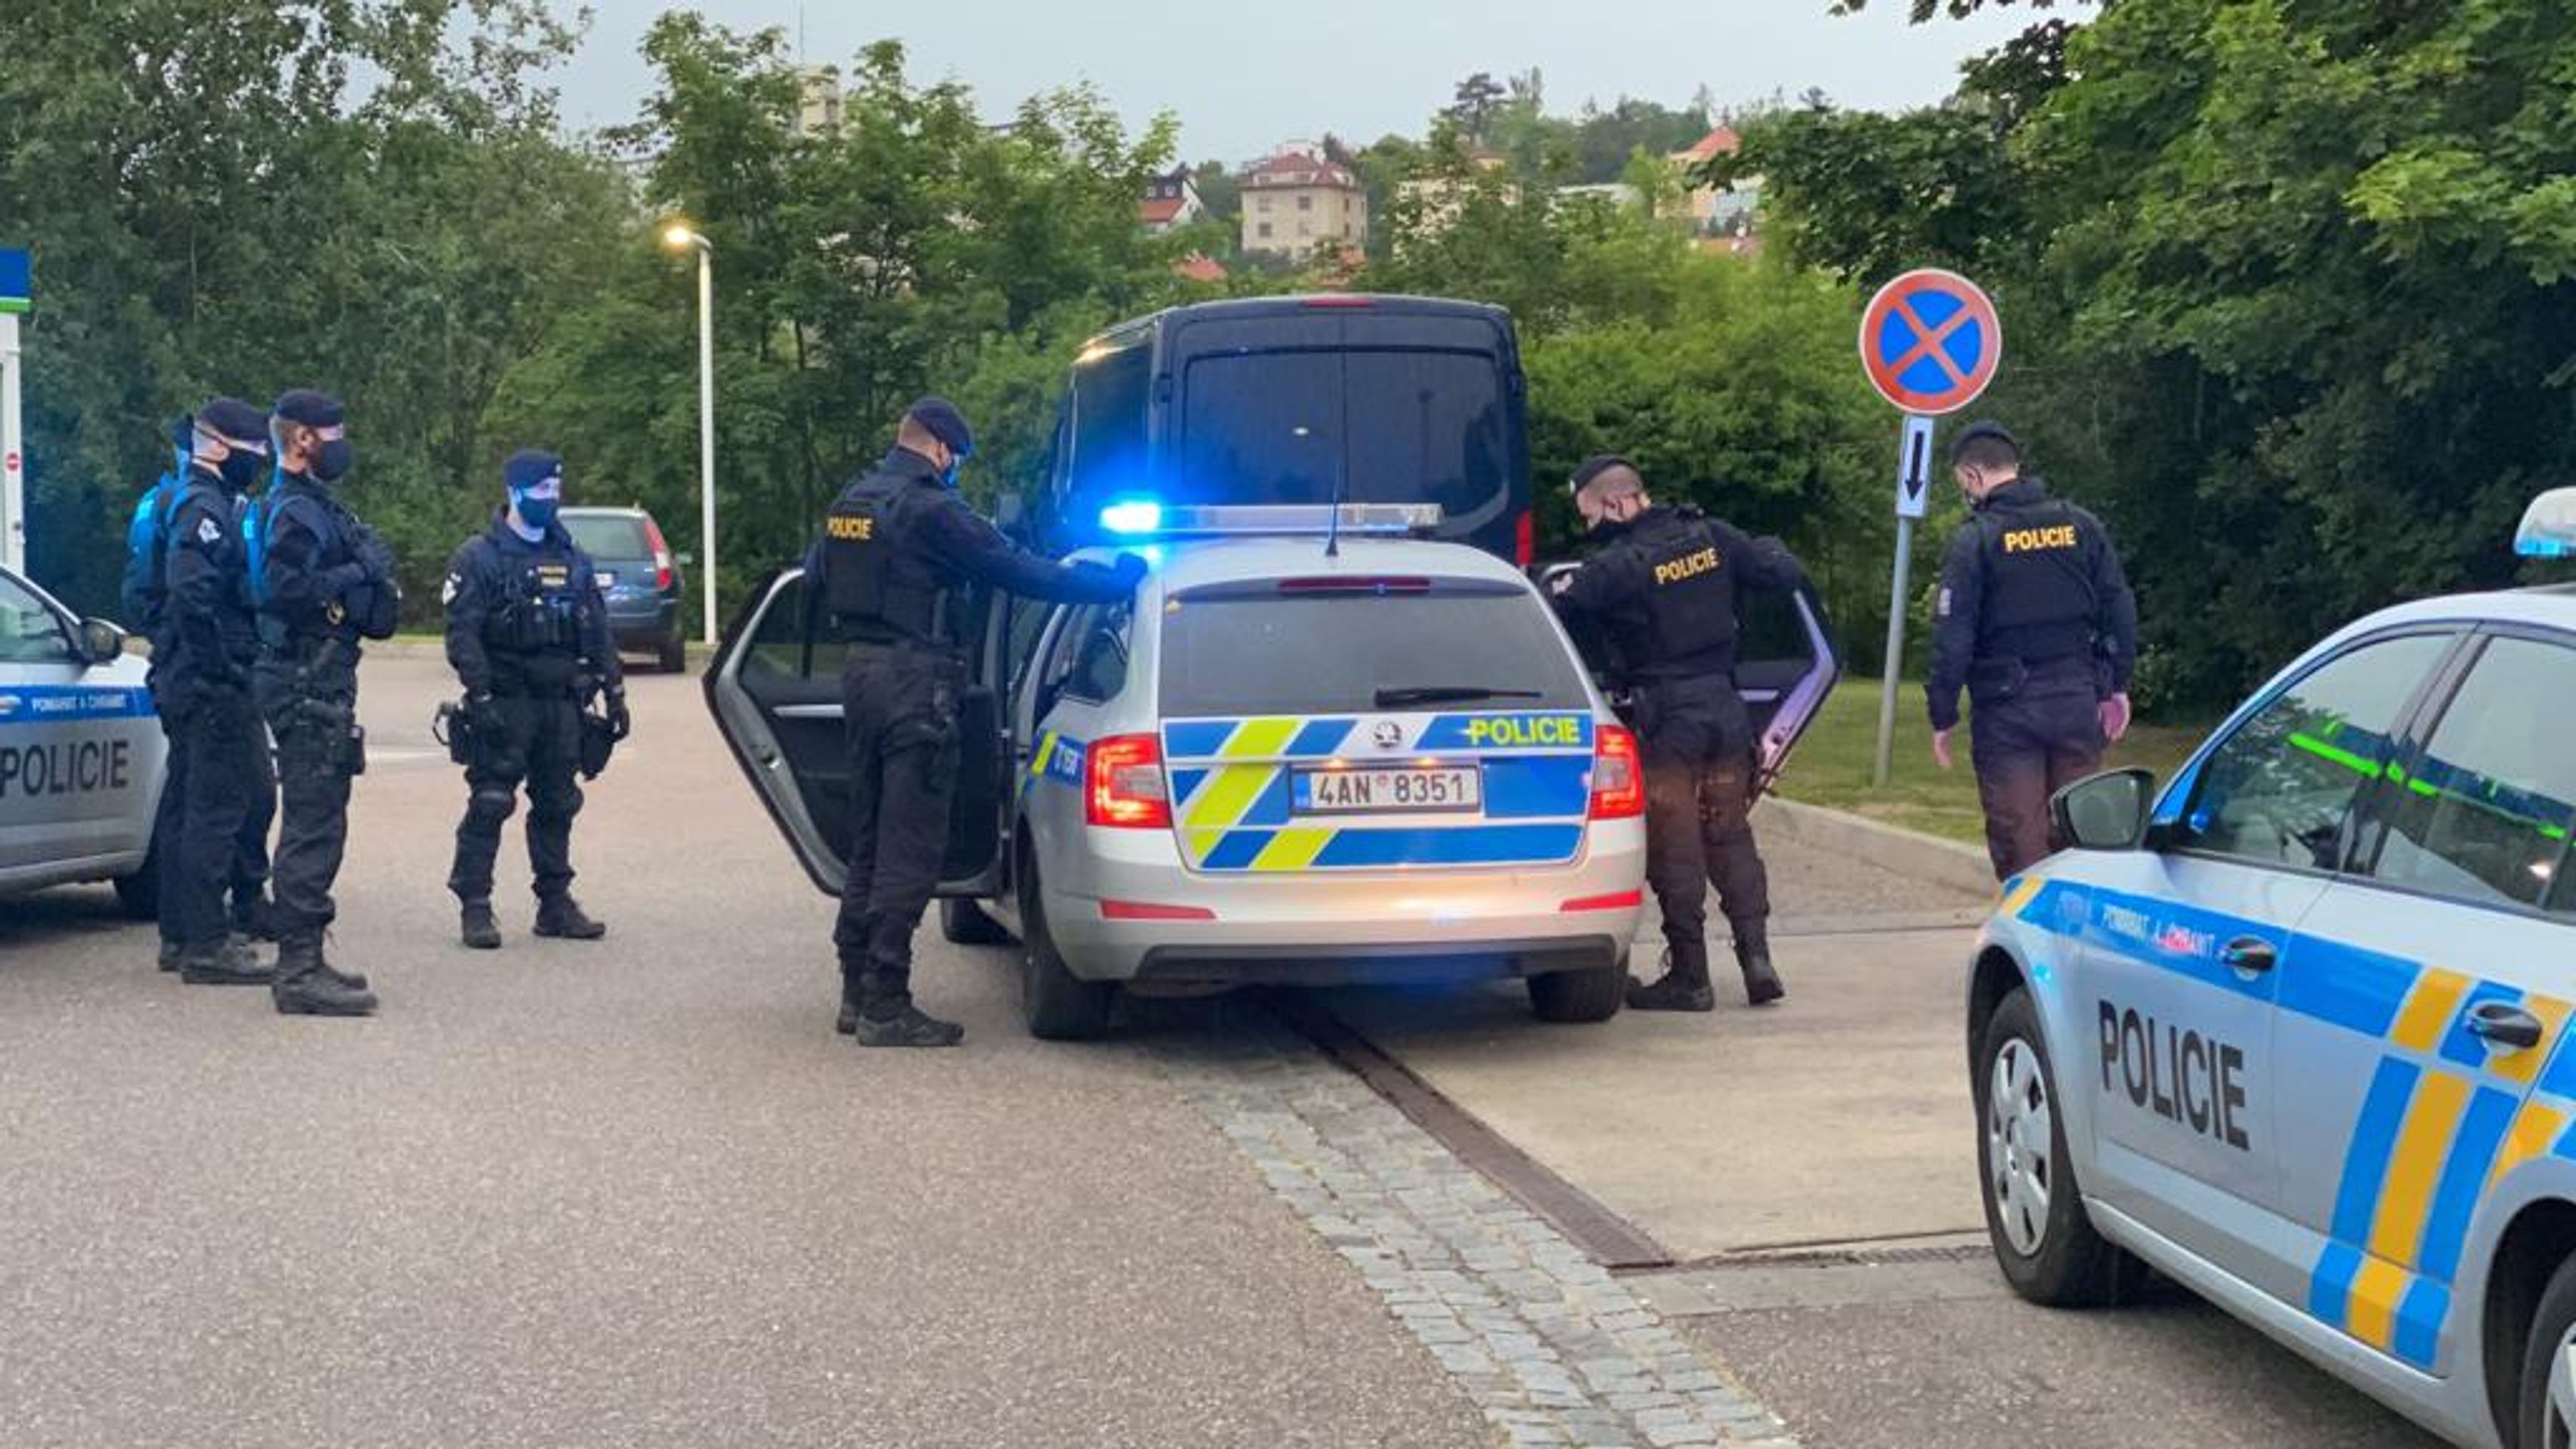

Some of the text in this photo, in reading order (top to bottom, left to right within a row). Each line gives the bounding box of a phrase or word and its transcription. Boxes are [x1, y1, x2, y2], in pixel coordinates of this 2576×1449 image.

[2005, 525, 2076, 552] POLICIE
[1655, 547, 1719, 584] POLICIE
[1468, 717, 1581, 746] POLICIE
[0, 739, 129, 798] POLICIE
[1318, 772, 1463, 805] 4AN 8351
[2099, 999, 2251, 1151] POLICIE
